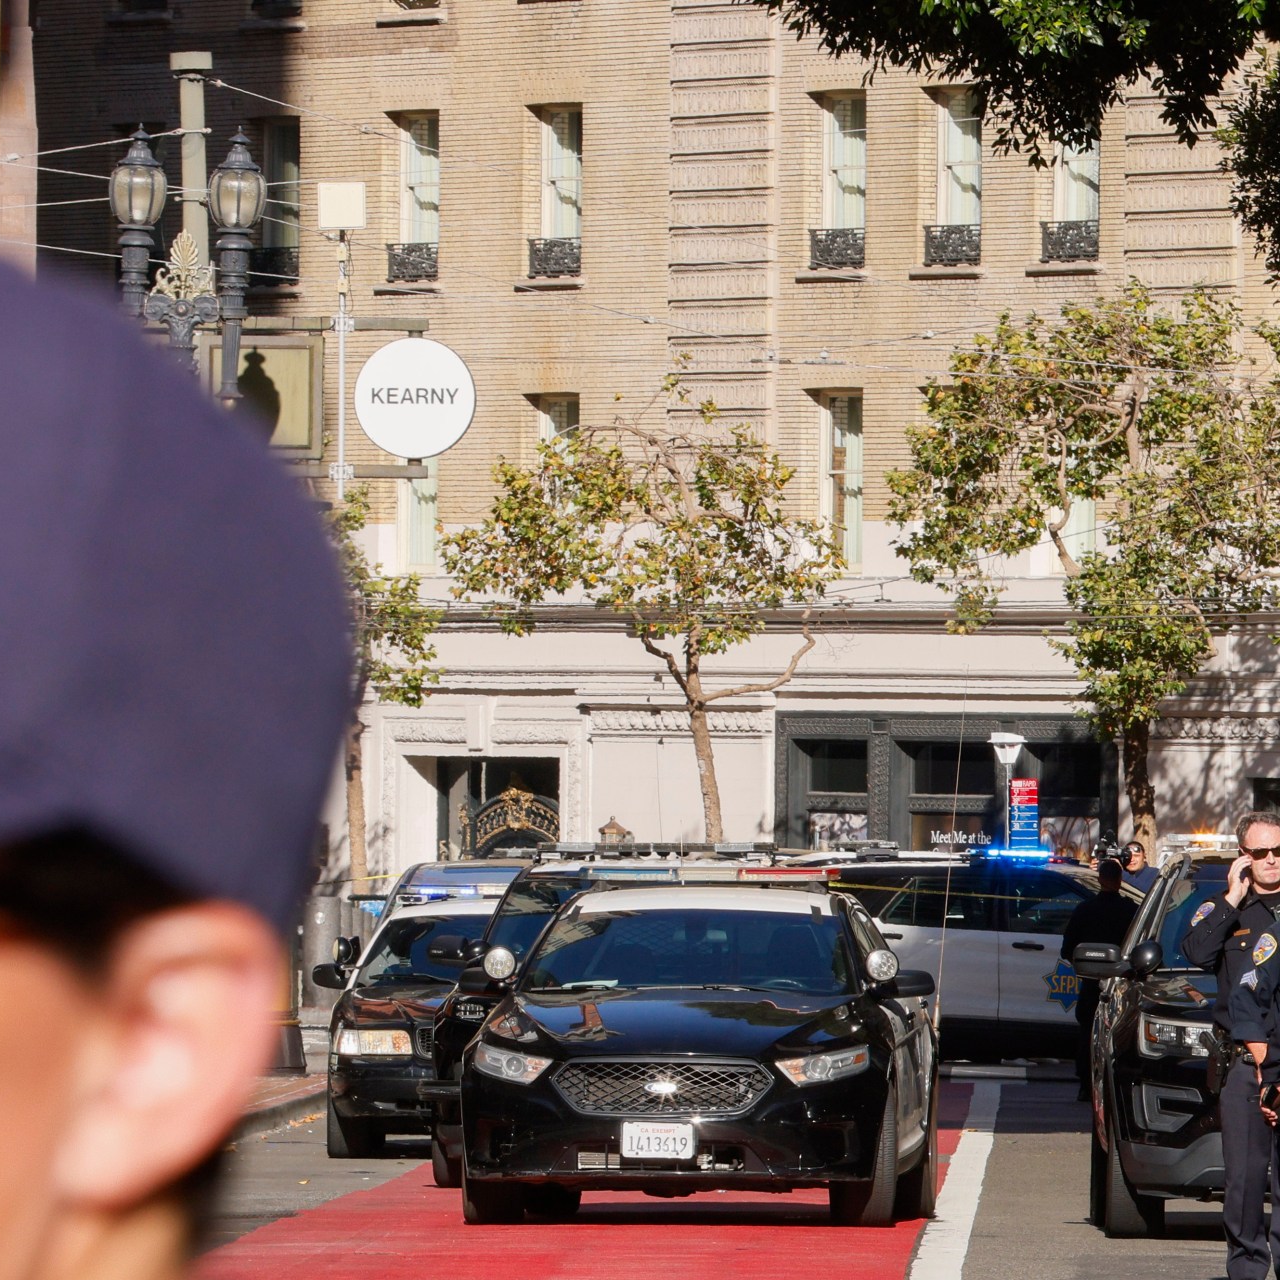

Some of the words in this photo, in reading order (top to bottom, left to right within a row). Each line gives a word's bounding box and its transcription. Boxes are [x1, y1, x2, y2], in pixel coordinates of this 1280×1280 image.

[371, 387, 459, 404] KEARNY
[930, 831, 951, 844] Meet
[952, 831, 967, 844] Me
[968, 832, 976, 844] at
[977, 831, 992, 845] the
[627, 1135, 688, 1153] 1413619
